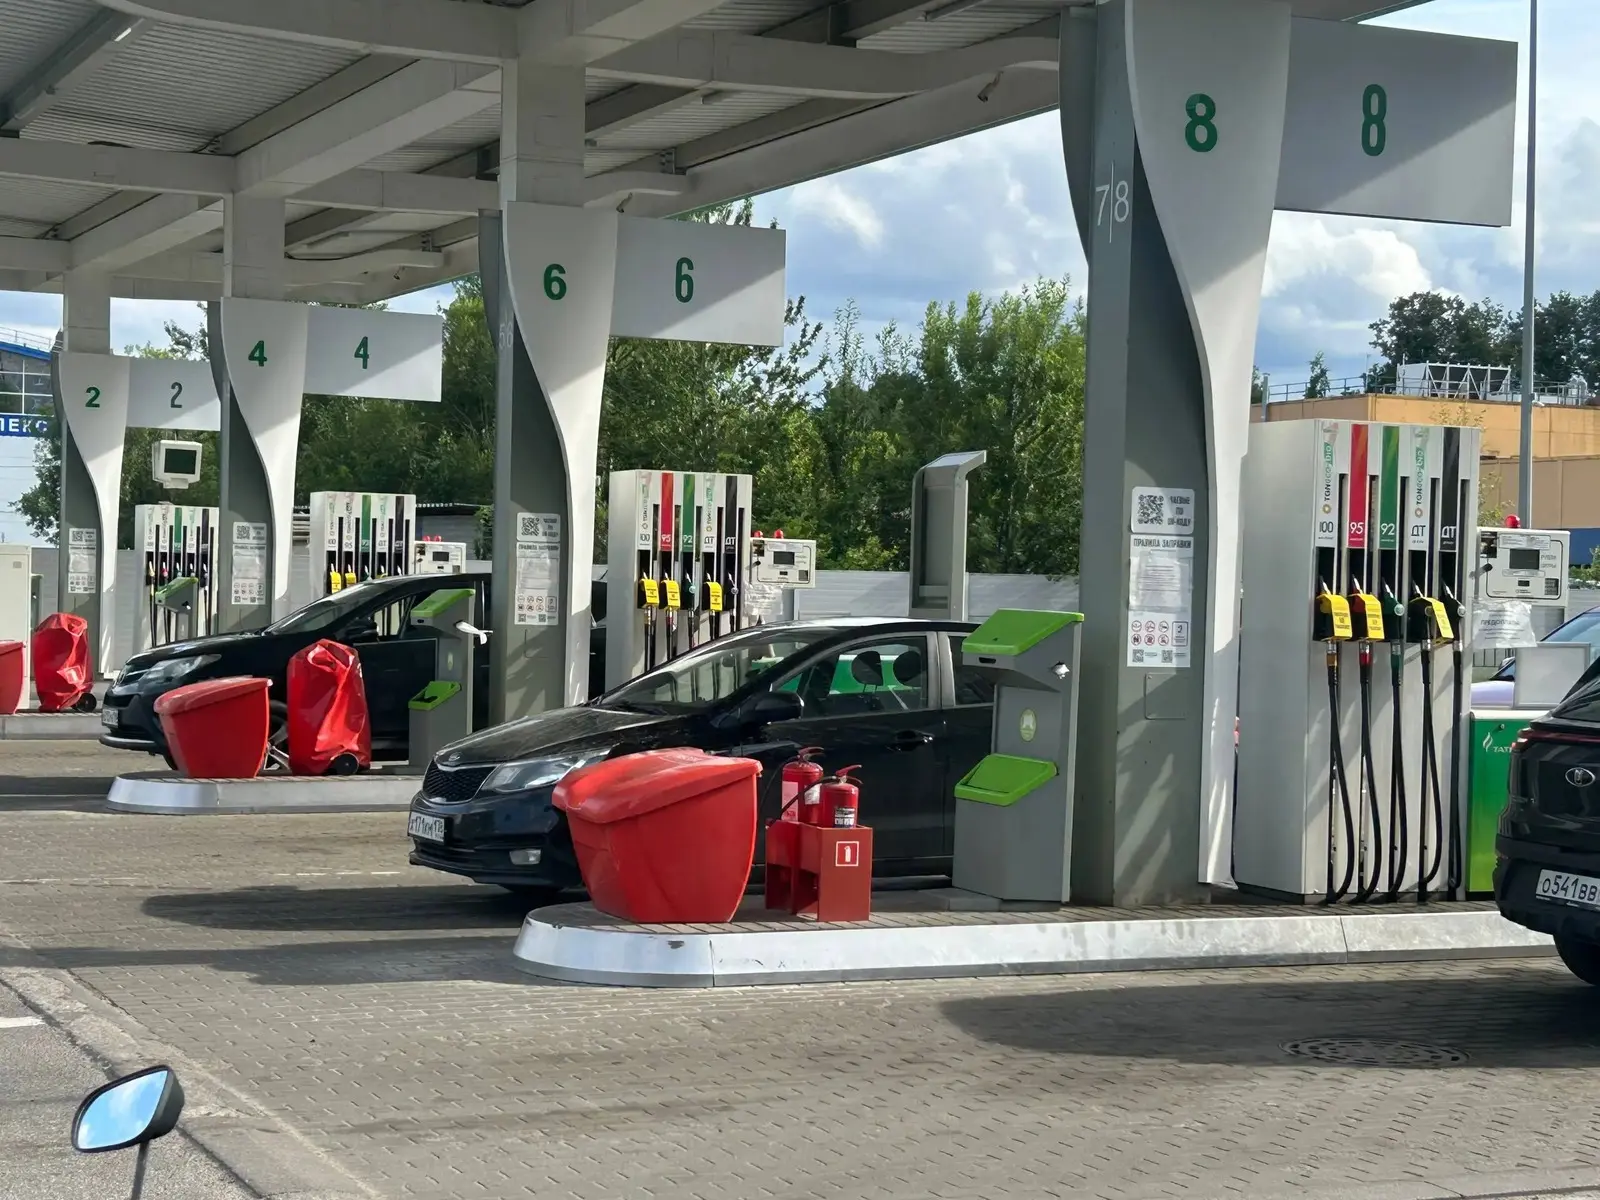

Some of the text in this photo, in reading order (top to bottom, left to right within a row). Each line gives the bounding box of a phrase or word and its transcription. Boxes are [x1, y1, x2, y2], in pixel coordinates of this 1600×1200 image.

[1185, 93, 1218, 153] 8
[1361, 84, 1388, 157] 8
[543, 263, 567, 300] 6
[675, 257, 694, 303] 6
[248, 340, 267, 367] 4
[354, 336, 369, 369] 4
[85, 386, 100, 408] 2
[170, 382, 183, 408] 2
[1319, 521, 1334, 533] 100
[1349, 521, 1364, 534] 95
[1380, 523, 1396, 536] 92
[1411, 525, 1426, 537] ДТ
[1441, 525, 1457, 538] ДТ
[661, 534, 672, 543] 95
[683, 535, 694, 543] 92
[1133, 538, 1192, 549] ПРАВИЛА ЗАПРАВКИ
